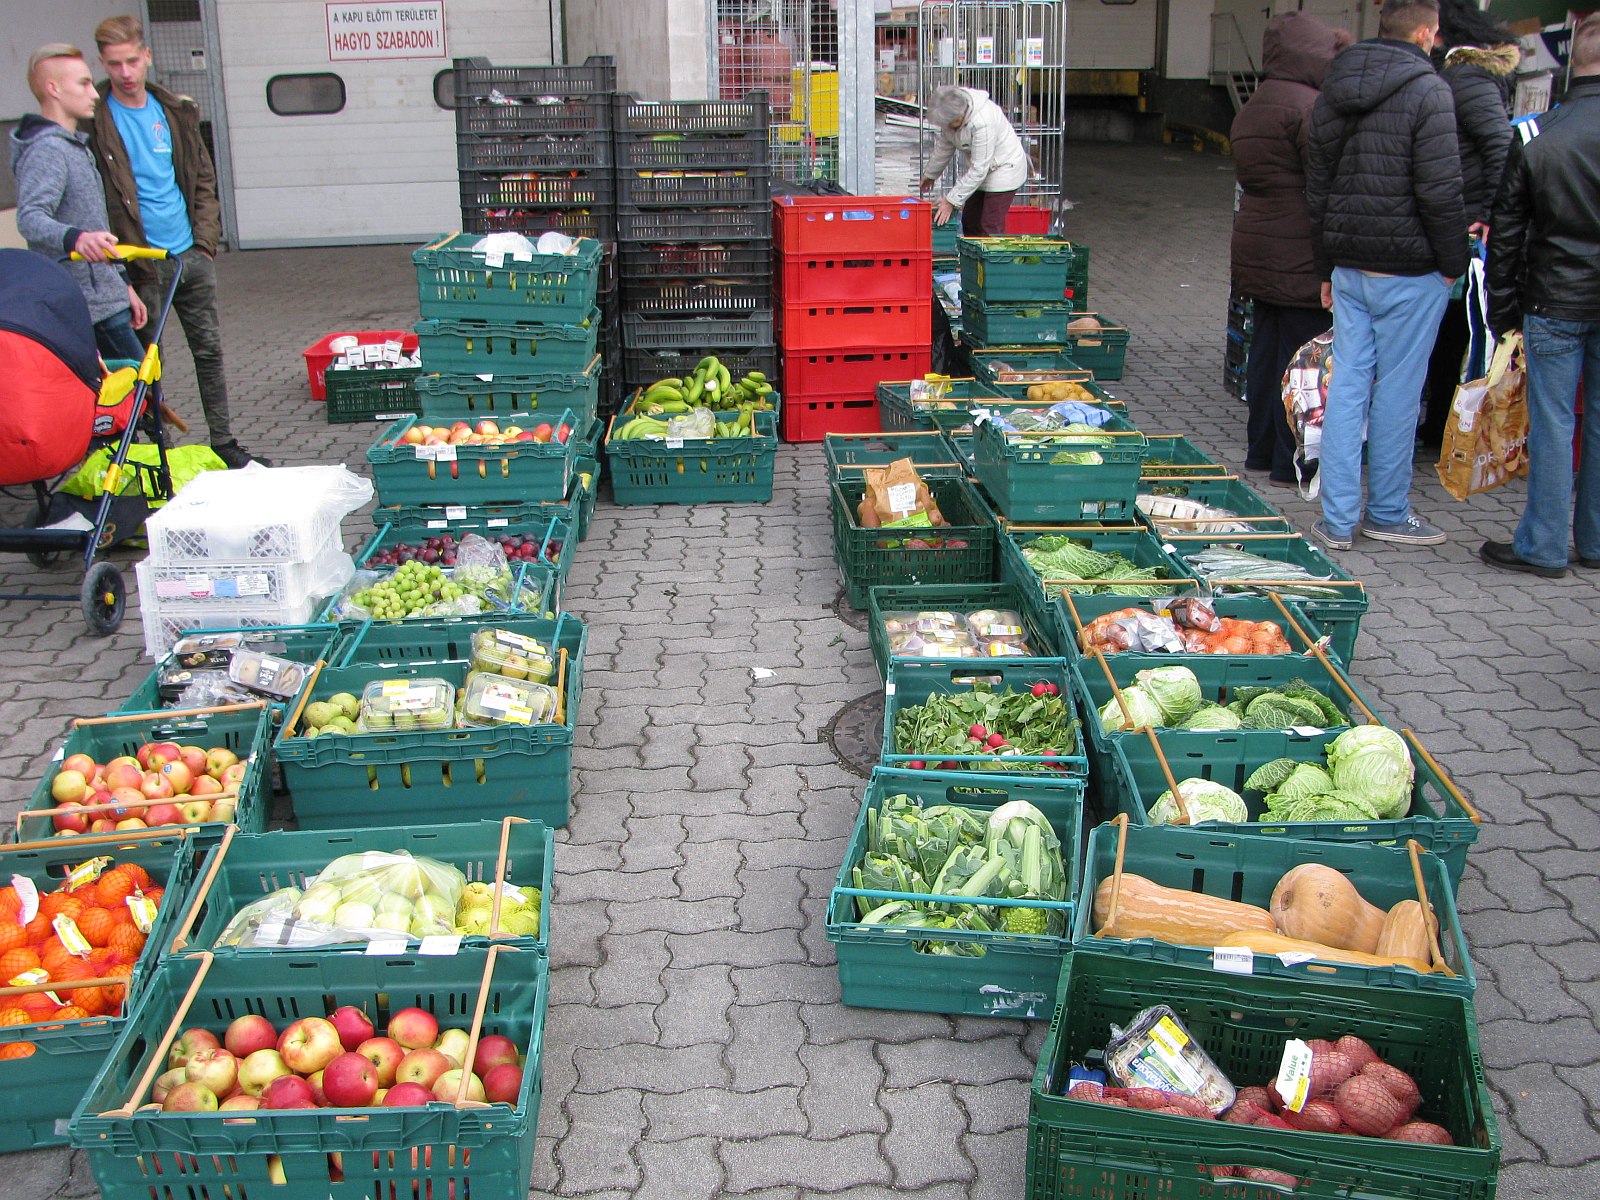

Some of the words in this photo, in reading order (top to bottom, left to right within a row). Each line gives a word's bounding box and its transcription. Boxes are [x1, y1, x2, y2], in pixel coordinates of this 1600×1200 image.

[333, 12, 339, 23] A
[342, 11, 363, 23] KAPU
[396, 8, 438, 21] TERÜLETET
[334, 32, 371, 51] HAGYD
[1285, 1055, 1299, 1081] Value
